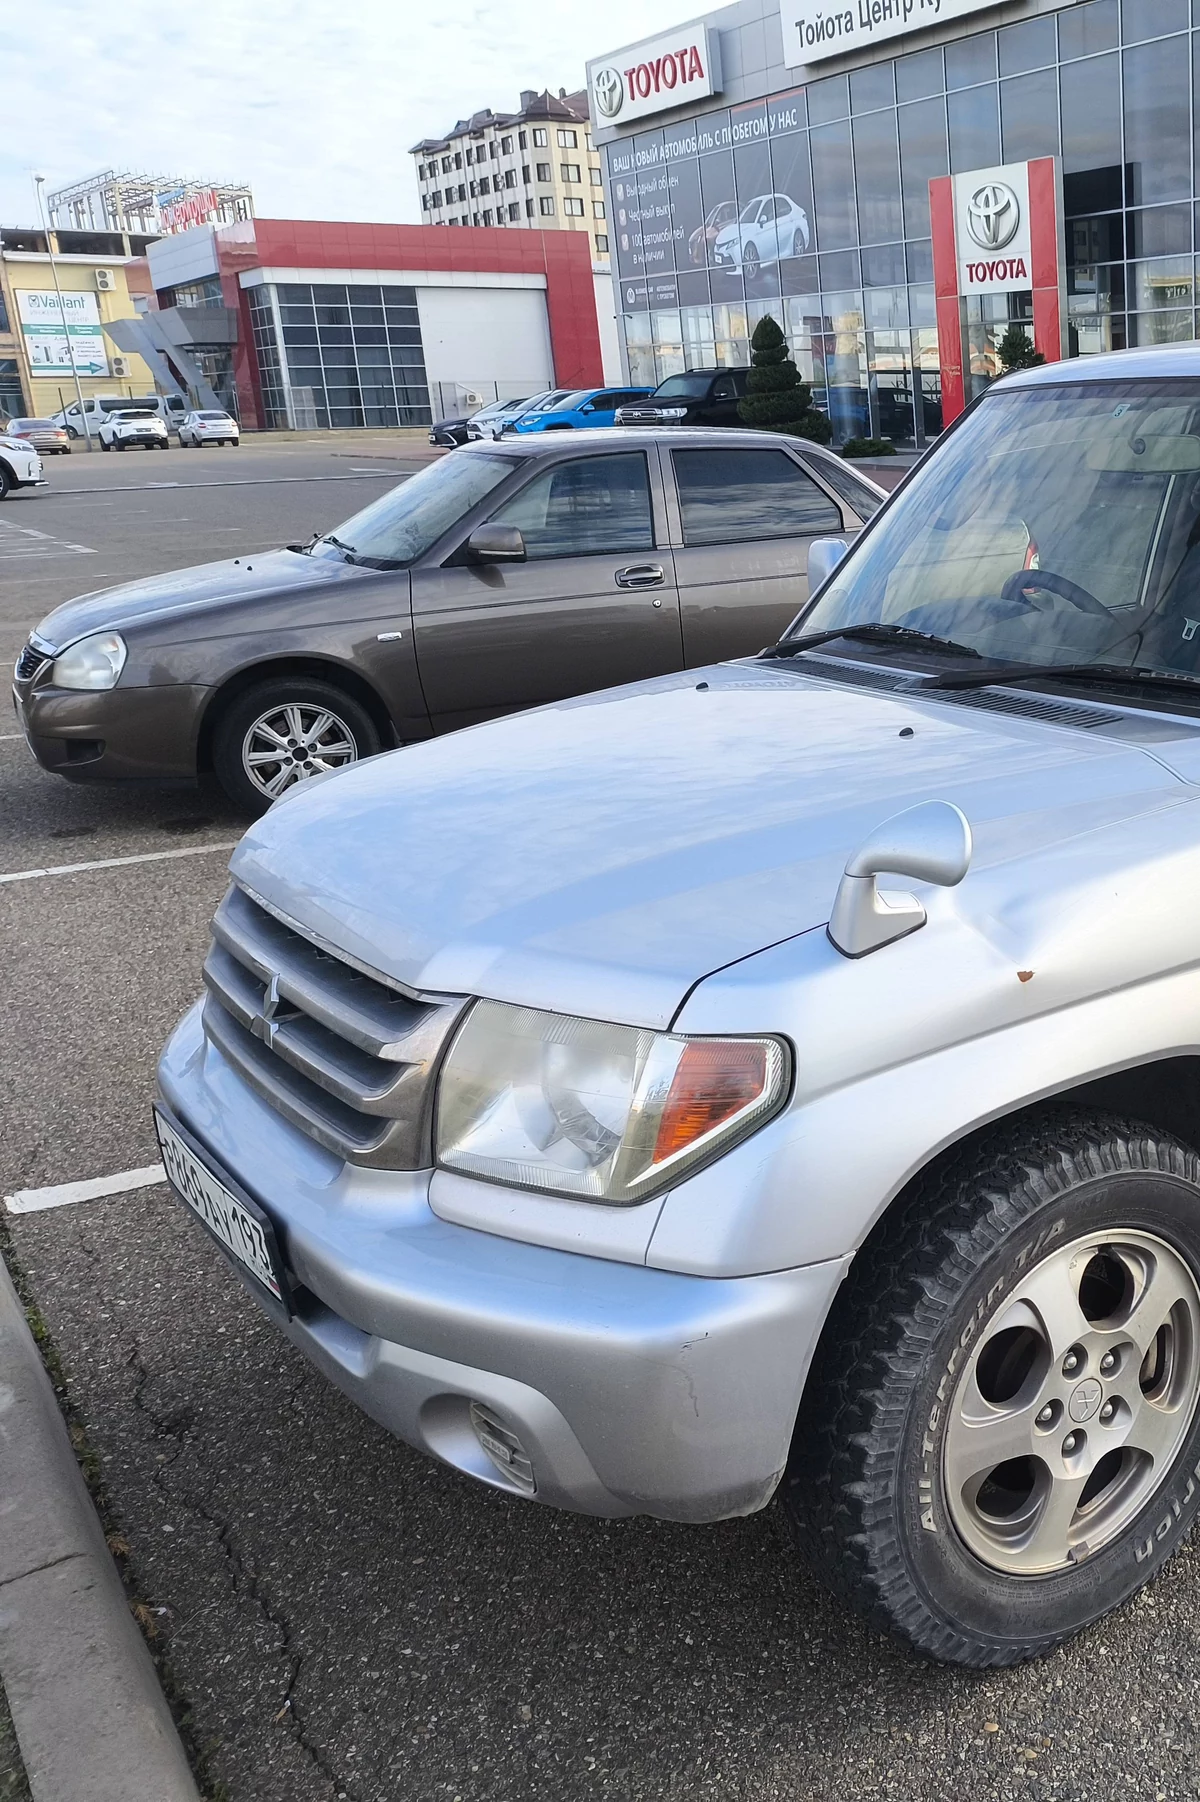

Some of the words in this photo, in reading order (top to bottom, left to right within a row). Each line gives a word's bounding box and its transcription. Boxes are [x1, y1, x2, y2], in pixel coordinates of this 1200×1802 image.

[794, 12, 854, 48] Тойота
[858, 0, 913, 31] Центр
[623, 45, 705, 101] TOYOTA
[613, 154, 630, 172] ВАШ
[714, 130, 721, 146] С
[777, 108, 798, 129] НАС
[966, 258, 1027, 283] TOYOTA
[1013, 1217, 1066, 1268] T/A
